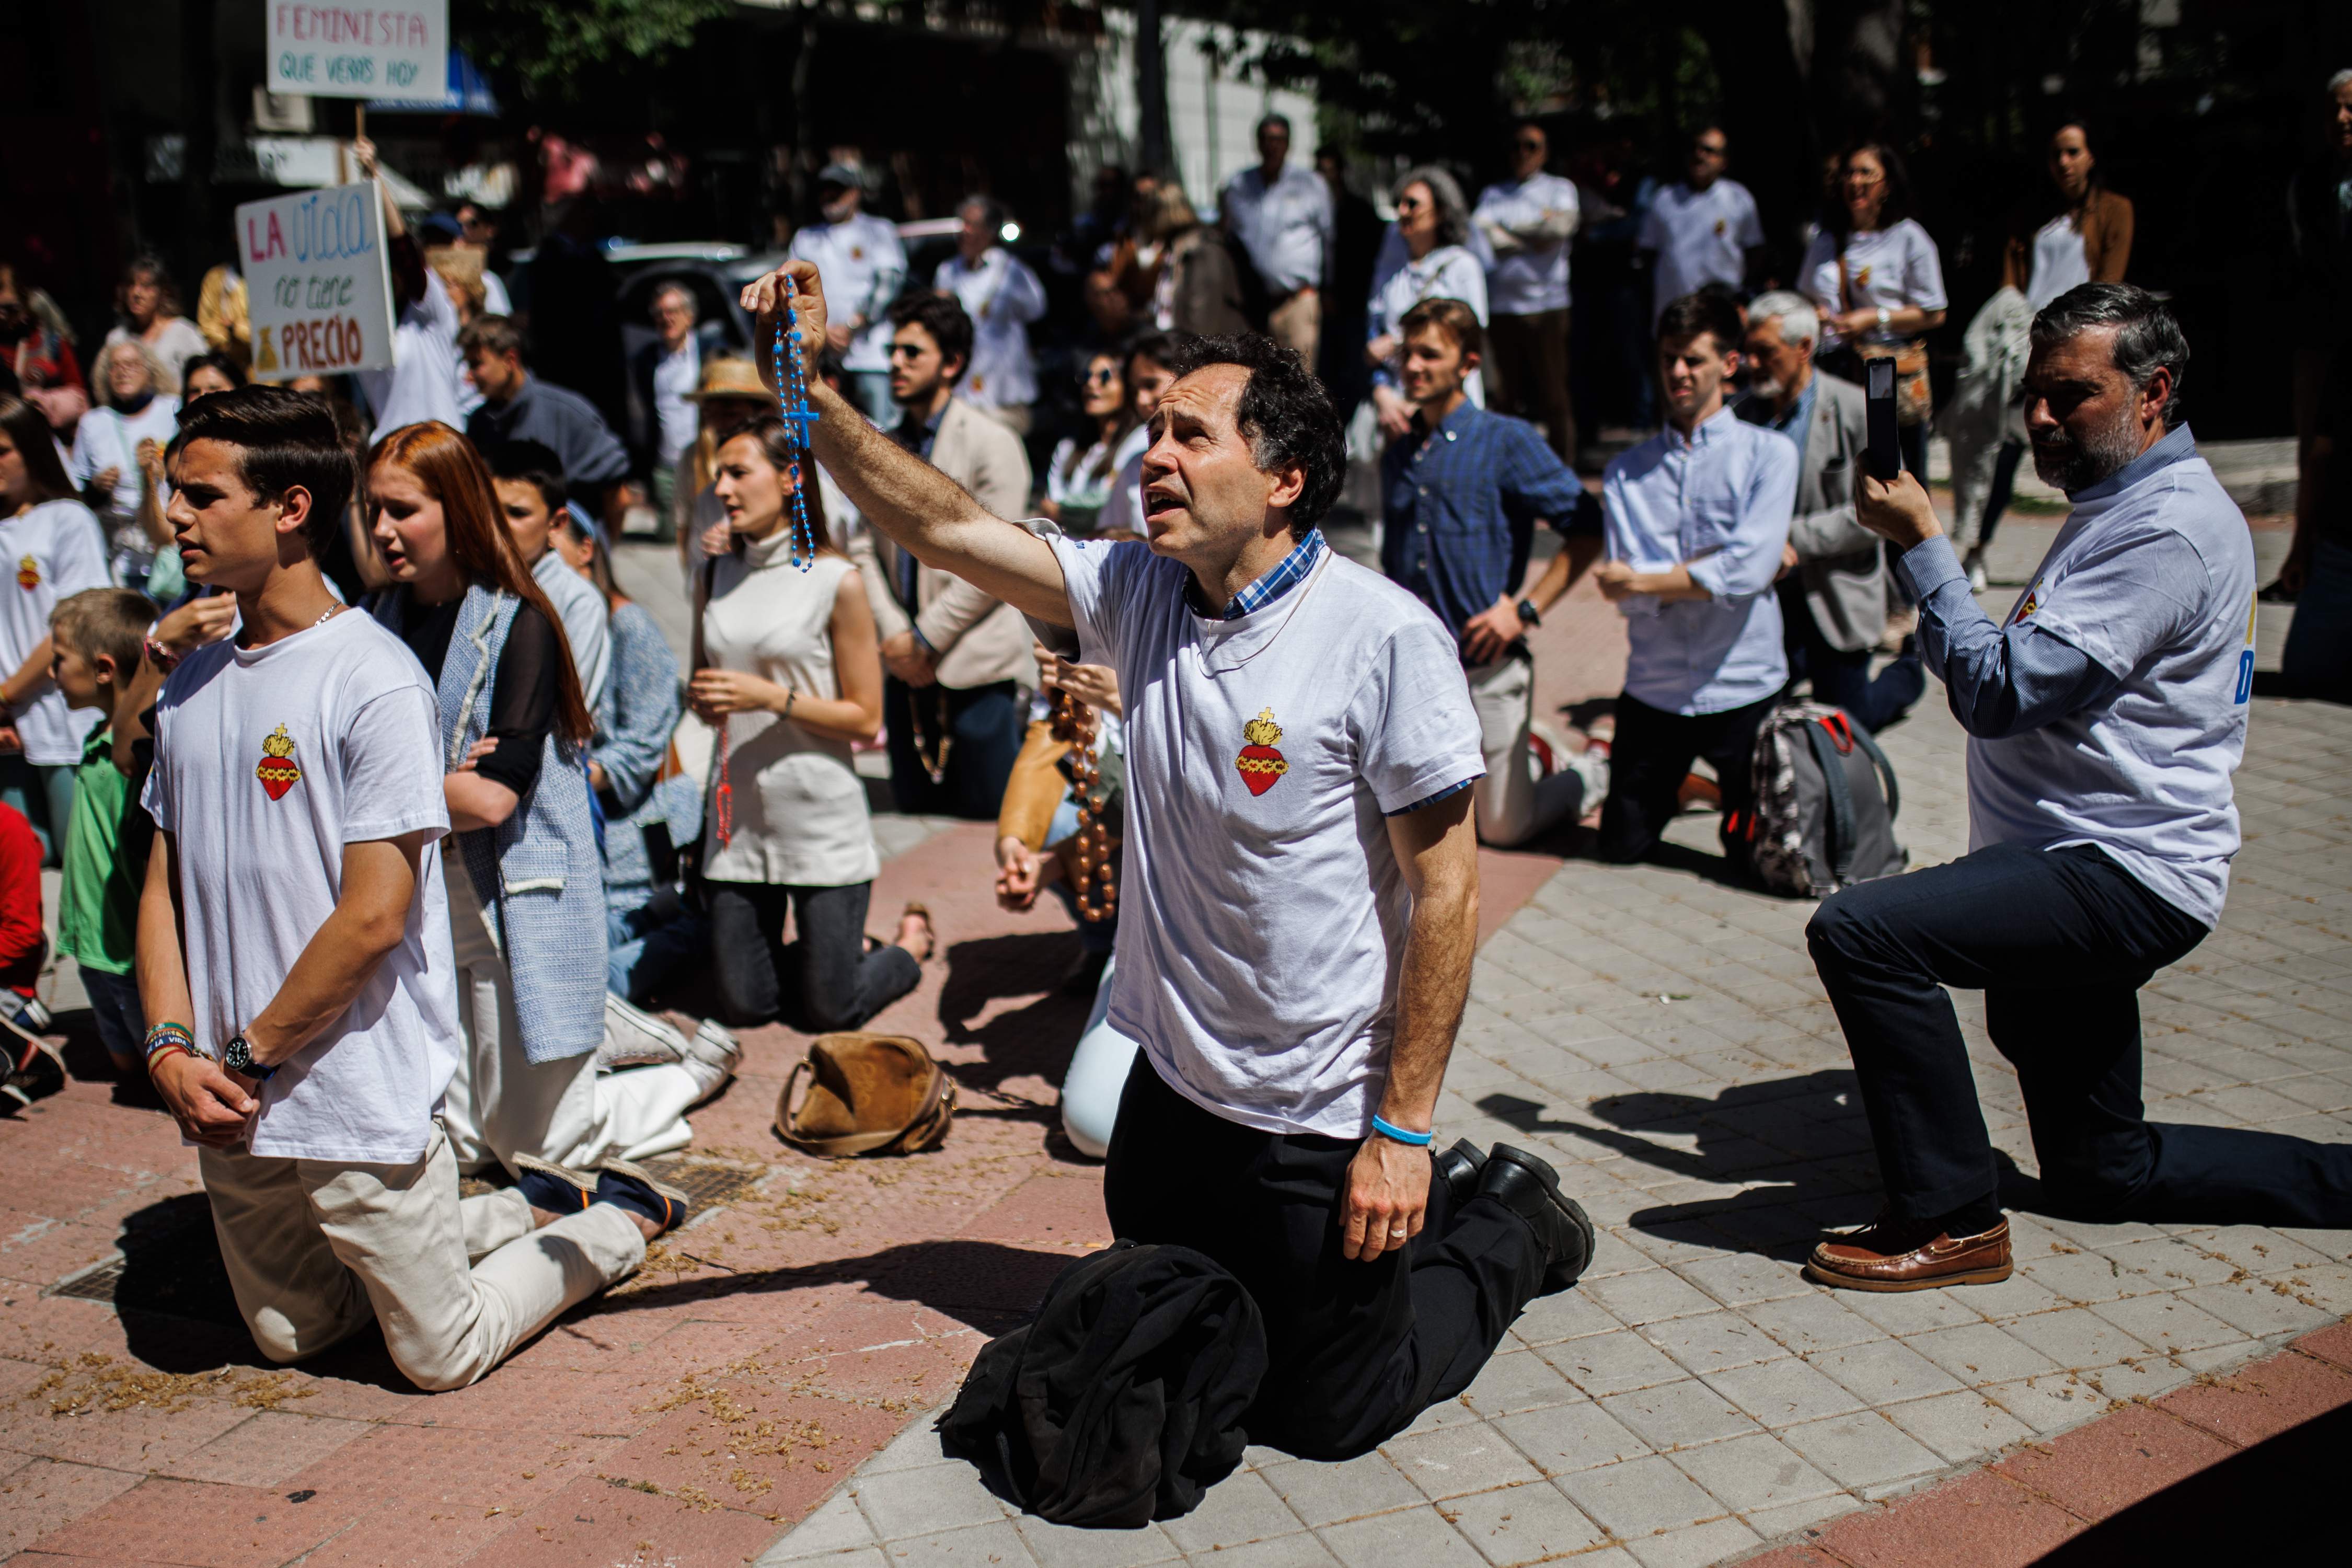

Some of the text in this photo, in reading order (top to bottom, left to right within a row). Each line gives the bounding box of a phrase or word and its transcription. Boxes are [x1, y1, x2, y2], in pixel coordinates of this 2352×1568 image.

[277, 4, 429, 50] FEMINISTA
[279, 51, 316, 84] QUE
[386, 59, 418, 87] HOY
[248, 210, 286, 262] LA
[274, 273, 353, 310] no tiene
[155, 1039, 164, 1047] LA
[168, 1036, 187, 1046] VIDA
